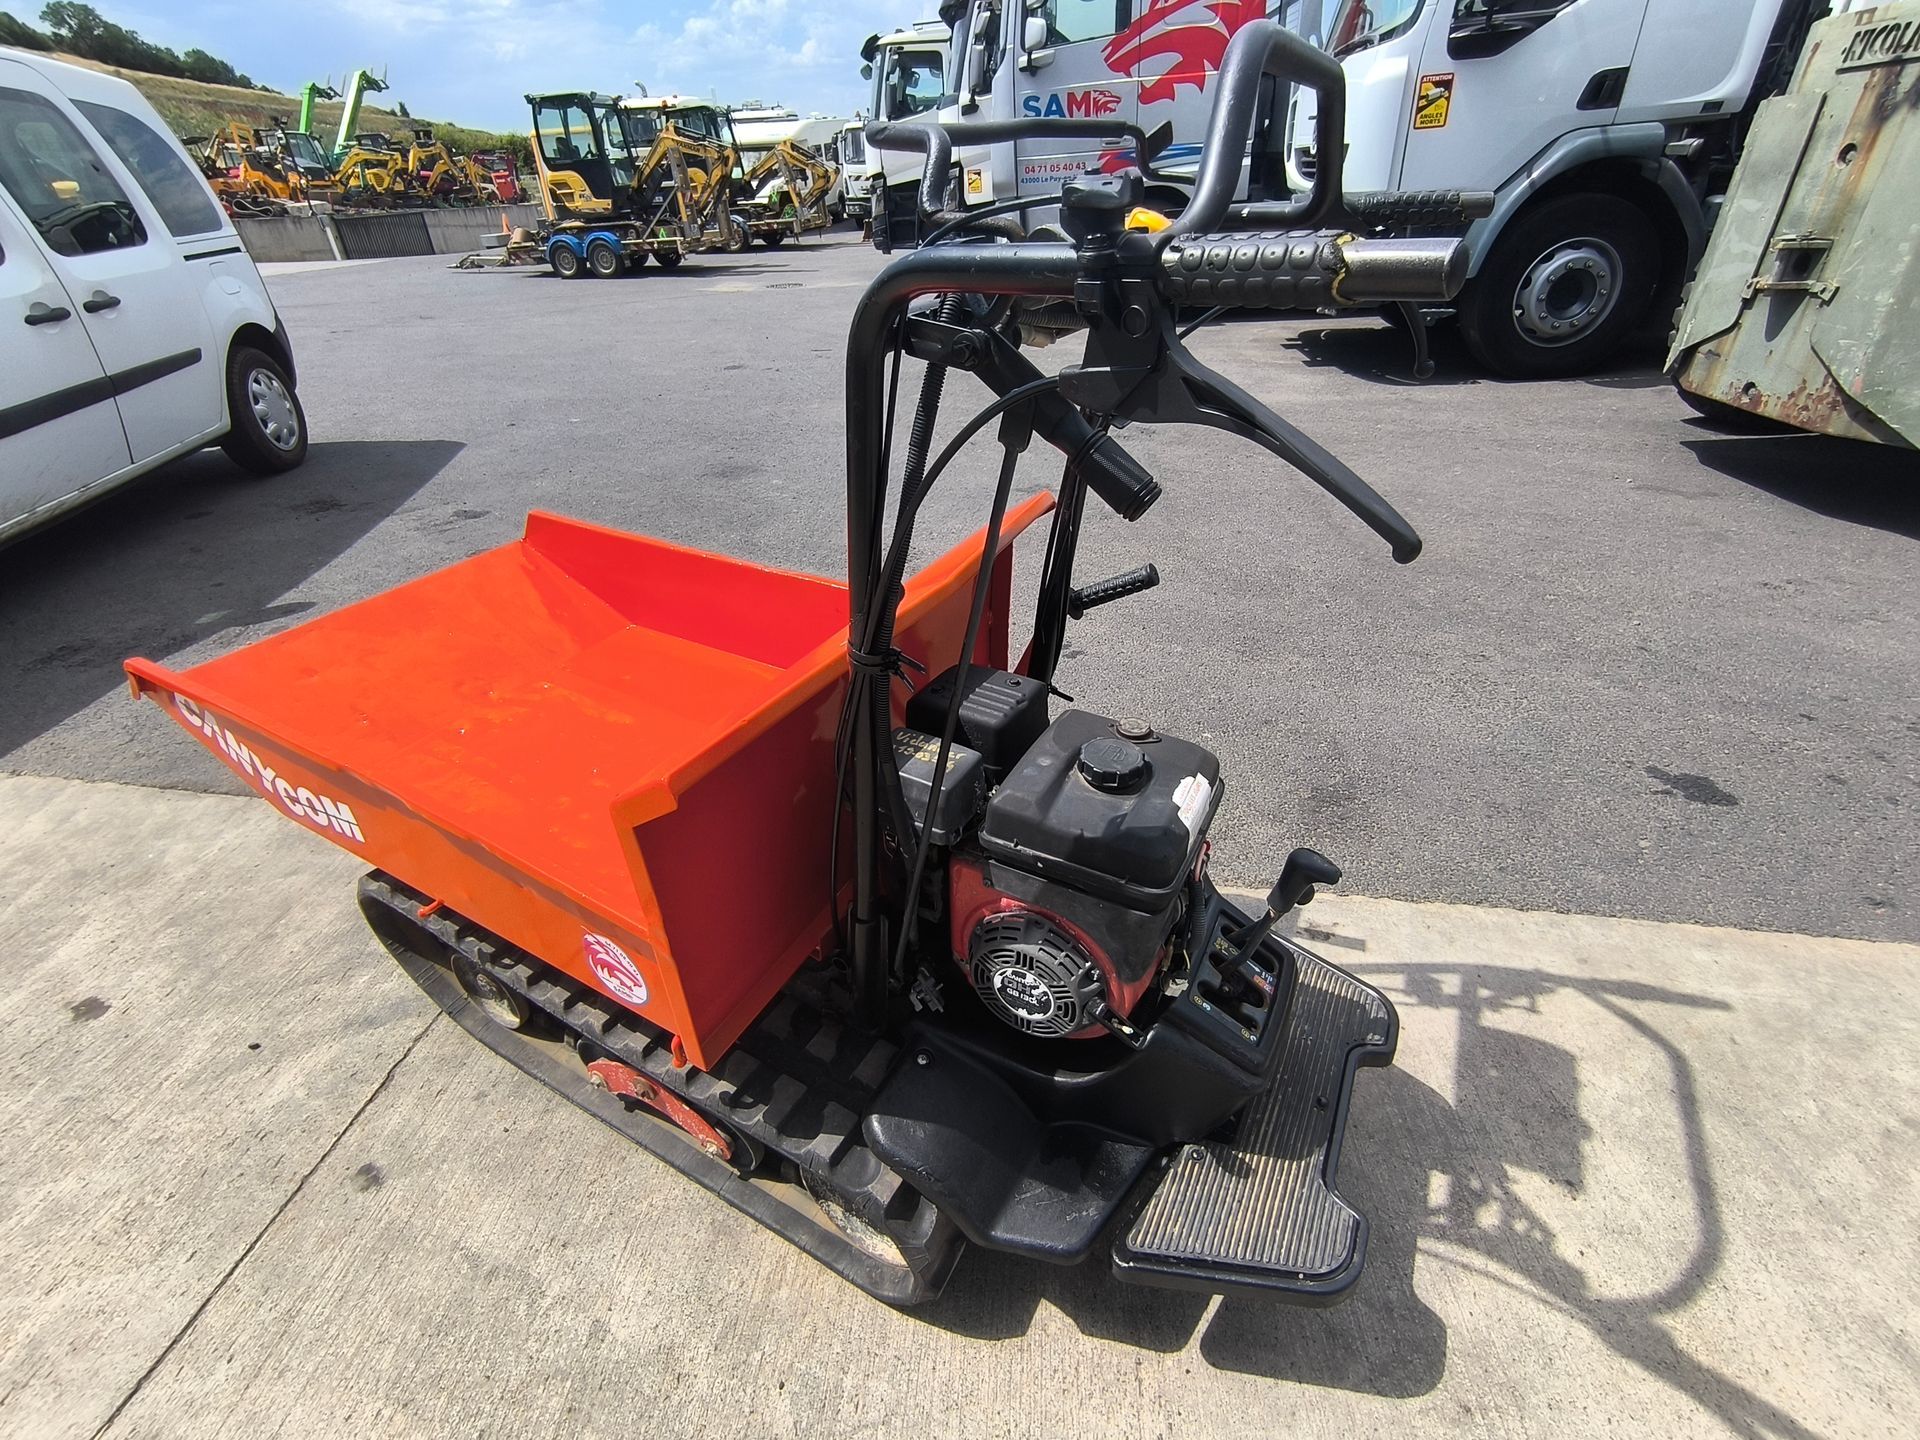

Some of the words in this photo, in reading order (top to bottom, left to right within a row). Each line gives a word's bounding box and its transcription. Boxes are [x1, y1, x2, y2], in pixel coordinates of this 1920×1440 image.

[1022, 90, 1092, 119] SAM
[1420, 112, 1443, 120] ANGLES
[1024, 166, 1036, 175] 04
[1037, 165, 1047, 174] 71
[1050, 164, 1061, 173] 05
[1063, 163, 1074, 172] 40
[1075, 161, 1087, 171] 43
[174, 691, 366, 843] CANYCOM
